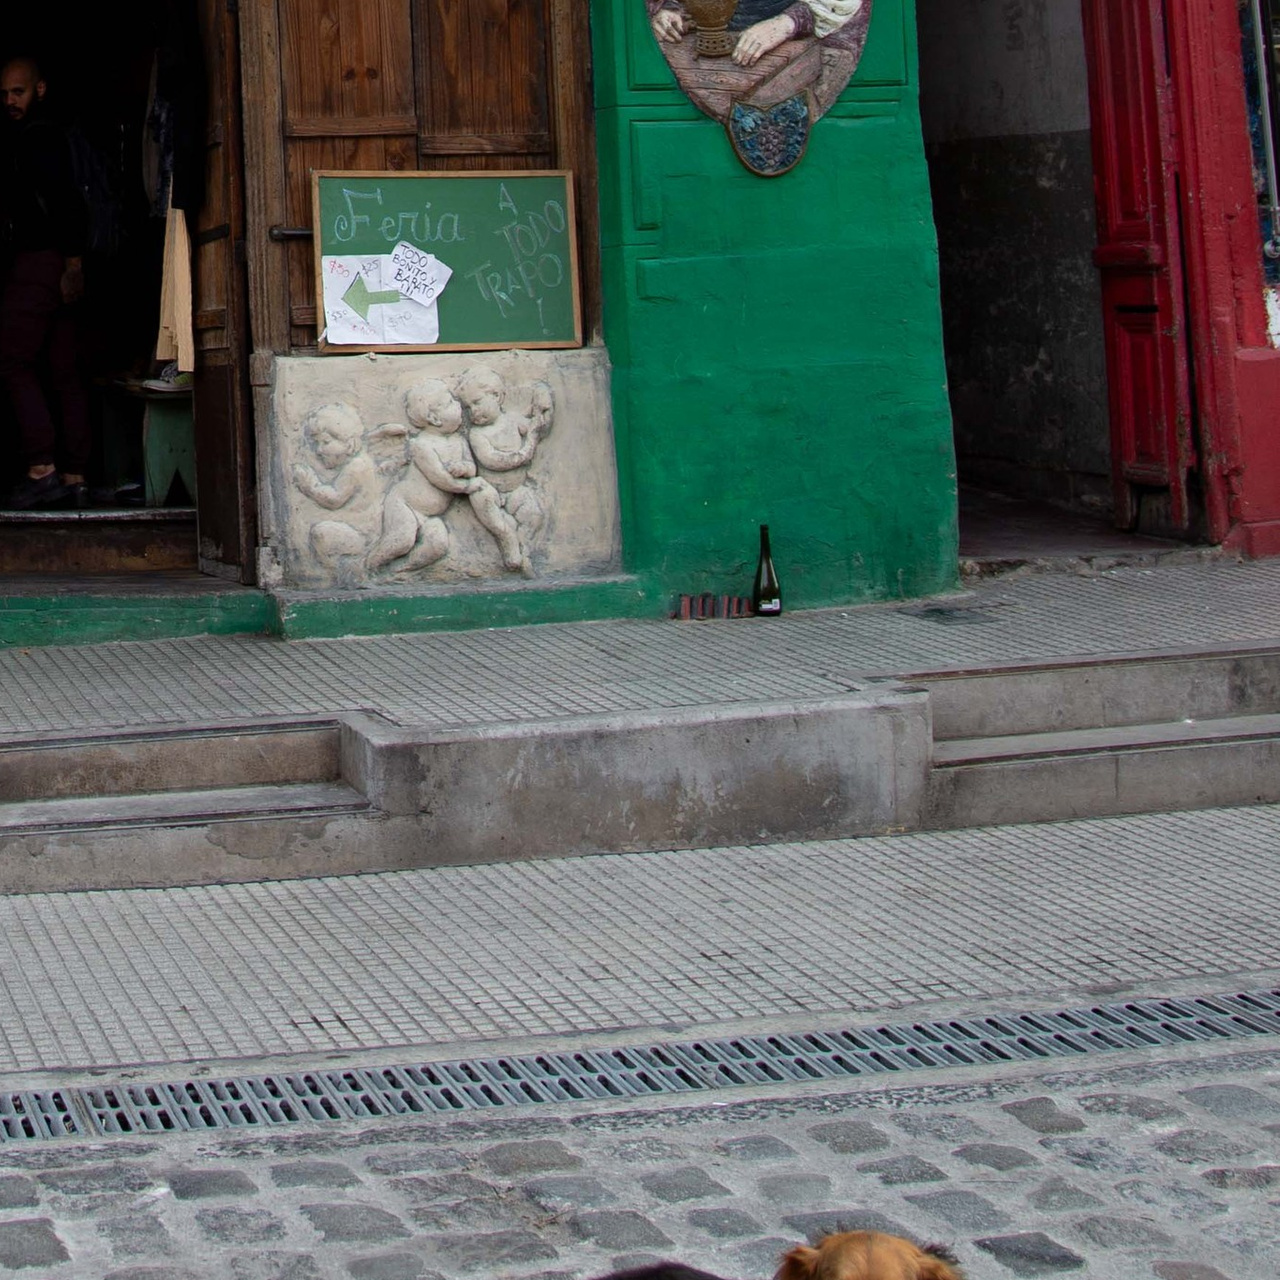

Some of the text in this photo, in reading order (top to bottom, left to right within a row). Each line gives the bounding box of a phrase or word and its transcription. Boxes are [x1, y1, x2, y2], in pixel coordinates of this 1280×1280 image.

[330, 187, 466, 244] Feria
[392, 253, 428, 281] BONITO
[400, 244, 428, 268] TODO
[394, 268, 435, 299] BARATO
